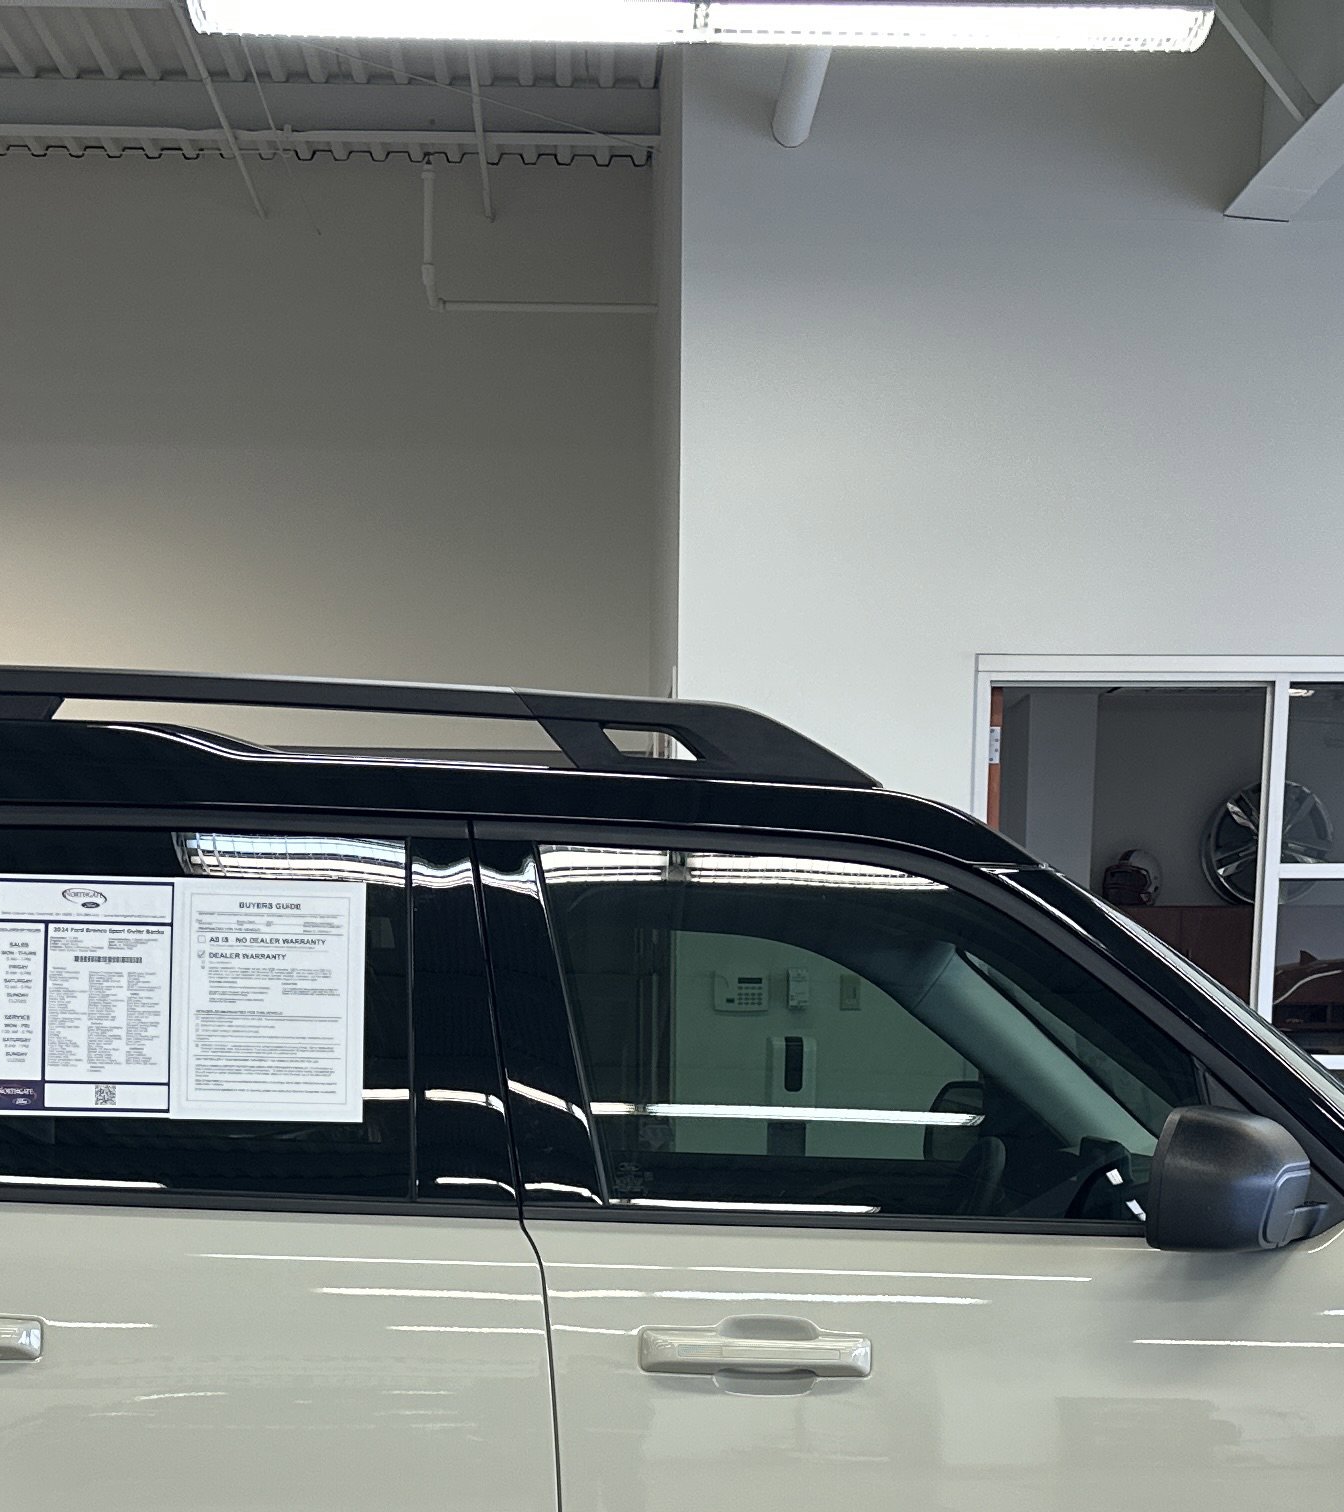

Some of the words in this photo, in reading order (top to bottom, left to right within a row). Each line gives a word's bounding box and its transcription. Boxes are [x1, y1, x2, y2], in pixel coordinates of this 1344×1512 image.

[239, 901, 273, 909] BUYERS
[250, 937, 280, 945] DEALER
[282, 938, 327, 946] WARRANTY
[242, 952, 286, 960] WARRANTY
